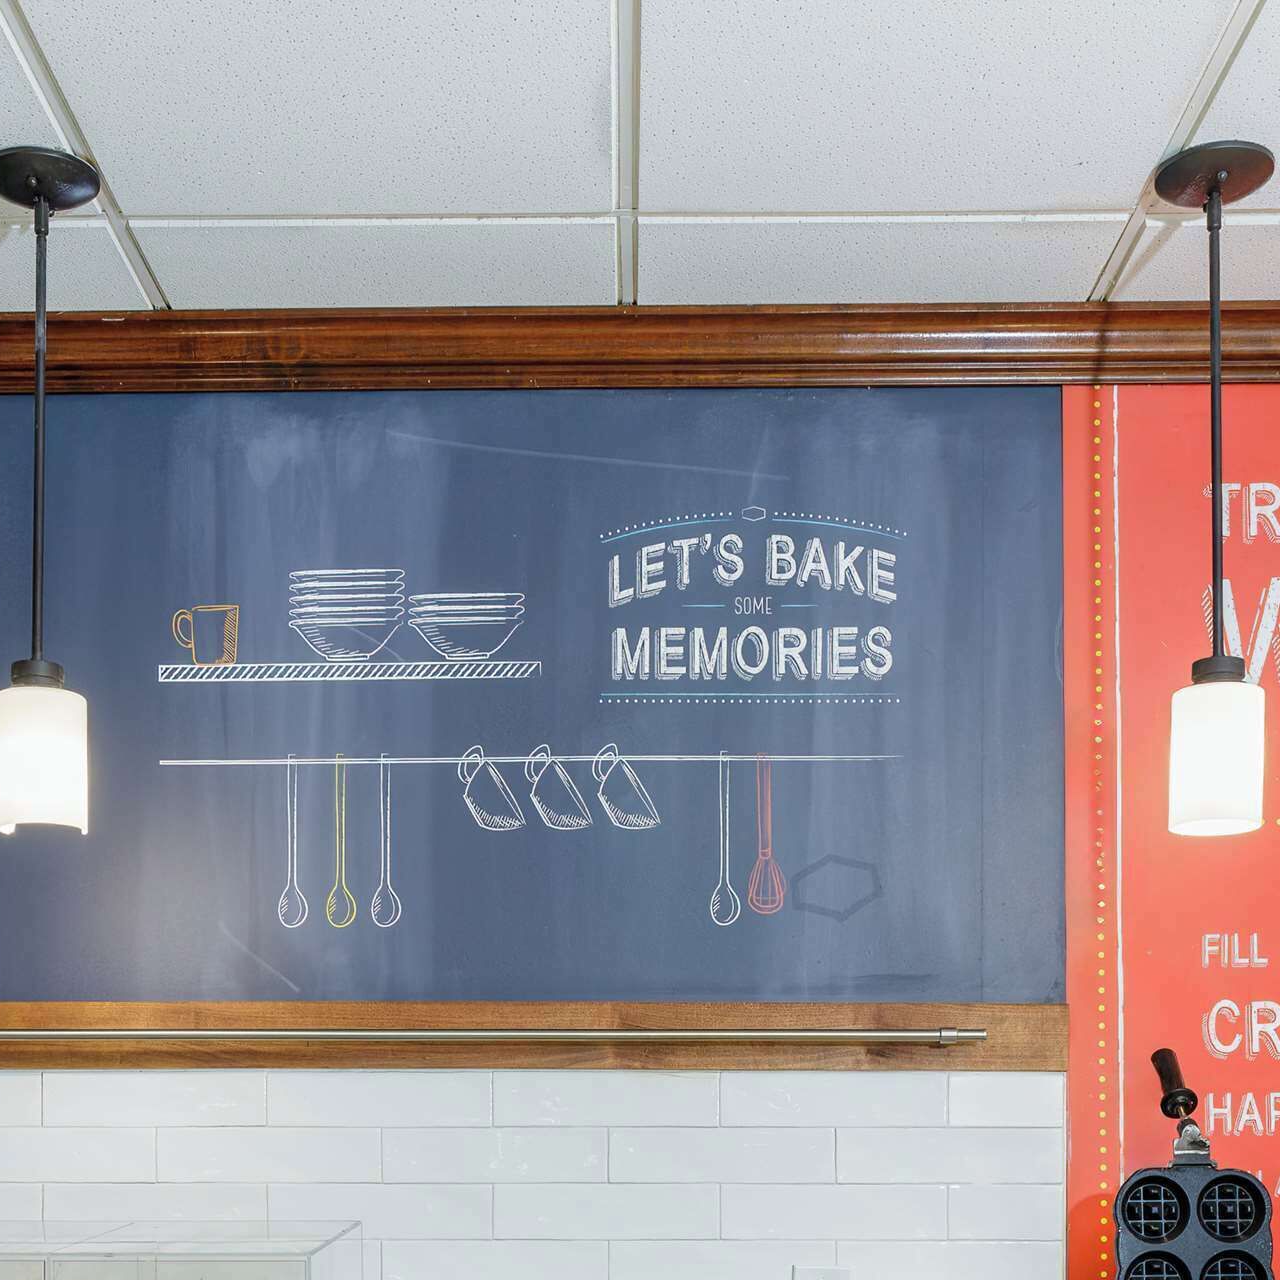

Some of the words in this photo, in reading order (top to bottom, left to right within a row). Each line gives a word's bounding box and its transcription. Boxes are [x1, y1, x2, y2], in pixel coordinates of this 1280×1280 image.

[608, 533, 745, 608] LET'S
[765, 534, 897, 604] BAKE
[734, 596, 773, 615] SOME
[611, 625, 894, 681] MEMORIES
[1202, 932, 1269, 968] FILL
